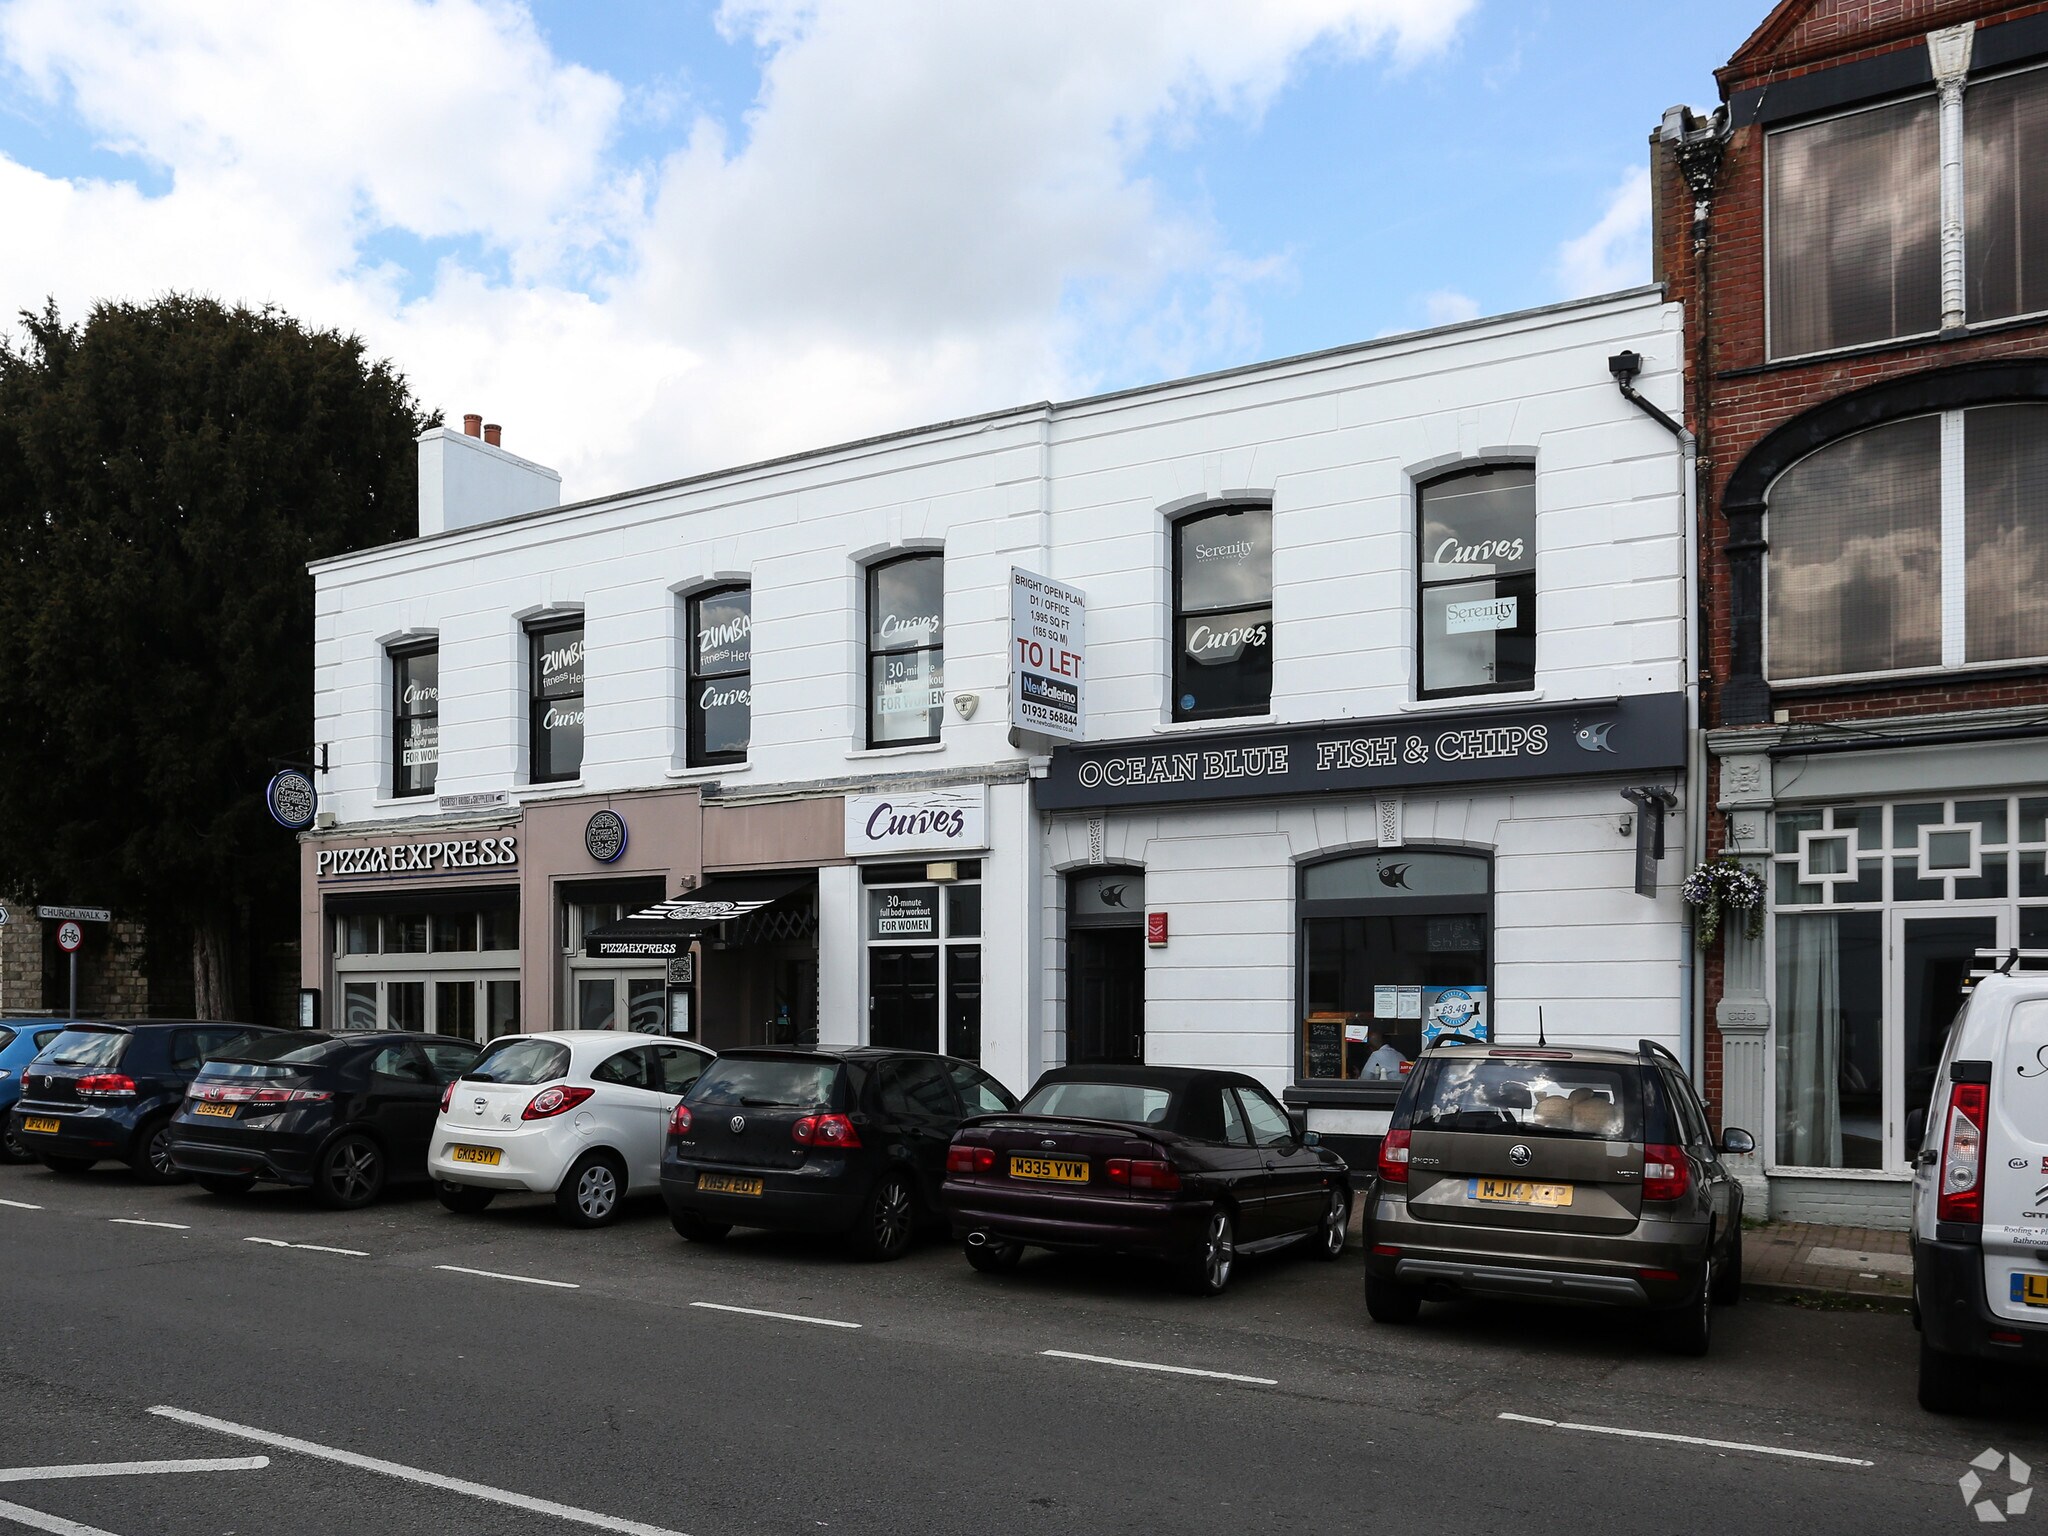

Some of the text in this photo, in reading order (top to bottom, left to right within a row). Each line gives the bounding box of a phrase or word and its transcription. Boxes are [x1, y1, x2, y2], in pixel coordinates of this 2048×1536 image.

[1195, 541, 1254, 565] Serenity
[1434, 538, 1524, 567] Curves
[1015, 575, 1042, 592] BRIGHT
[1044, 585, 1064, 600] OPEN
[1030, 595, 1039, 606] D1
[1045, 600, 1070, 616] OFFICE
[1049, 615, 1060, 628] SQ
[1061, 619, 1070, 630] FT
[1447, 602, 1515, 628] Serenity
[697, 614, 752, 653] ZUMBA
[880, 614, 939, 638] Curves
[1032, 625, 1069, 646] (185 SQ M)
[1188, 625, 1268, 653] Curves
[700, 650, 730, 666] fitness
[1017, 637, 1082, 678] TO LET
[543, 672, 569, 688] fitness
[1024, 676, 1076, 703] NewBallerino
[881, 697, 900, 711] FOR
[1022, 703, 1047, 719] 01932
[405, 752, 419, 763] FOR
[1078, 724, 1549, 788] OCEAN BLUE FISH & CHIPS
[865, 802, 965, 841] Curves
[887, 895, 922, 907] 30-minute
[41, 907, 101, 920] CHURCH WALK
[890, 908, 905, 918] body
[905, 907, 931, 916] workout
[881, 919, 929, 931] FOR WOMEN
[600, 943, 677, 954] PIZZAEXPRESS
[1440, 1003, 1468, 1015] £3.49
[457, 1148, 495, 1163] GK13 SYY
[1015, 1158, 1083, 1178] M335 YVW
[1483, 1181, 1523, 1198] MJ14
[2004, 1226, 2032, 1236] Roofing
